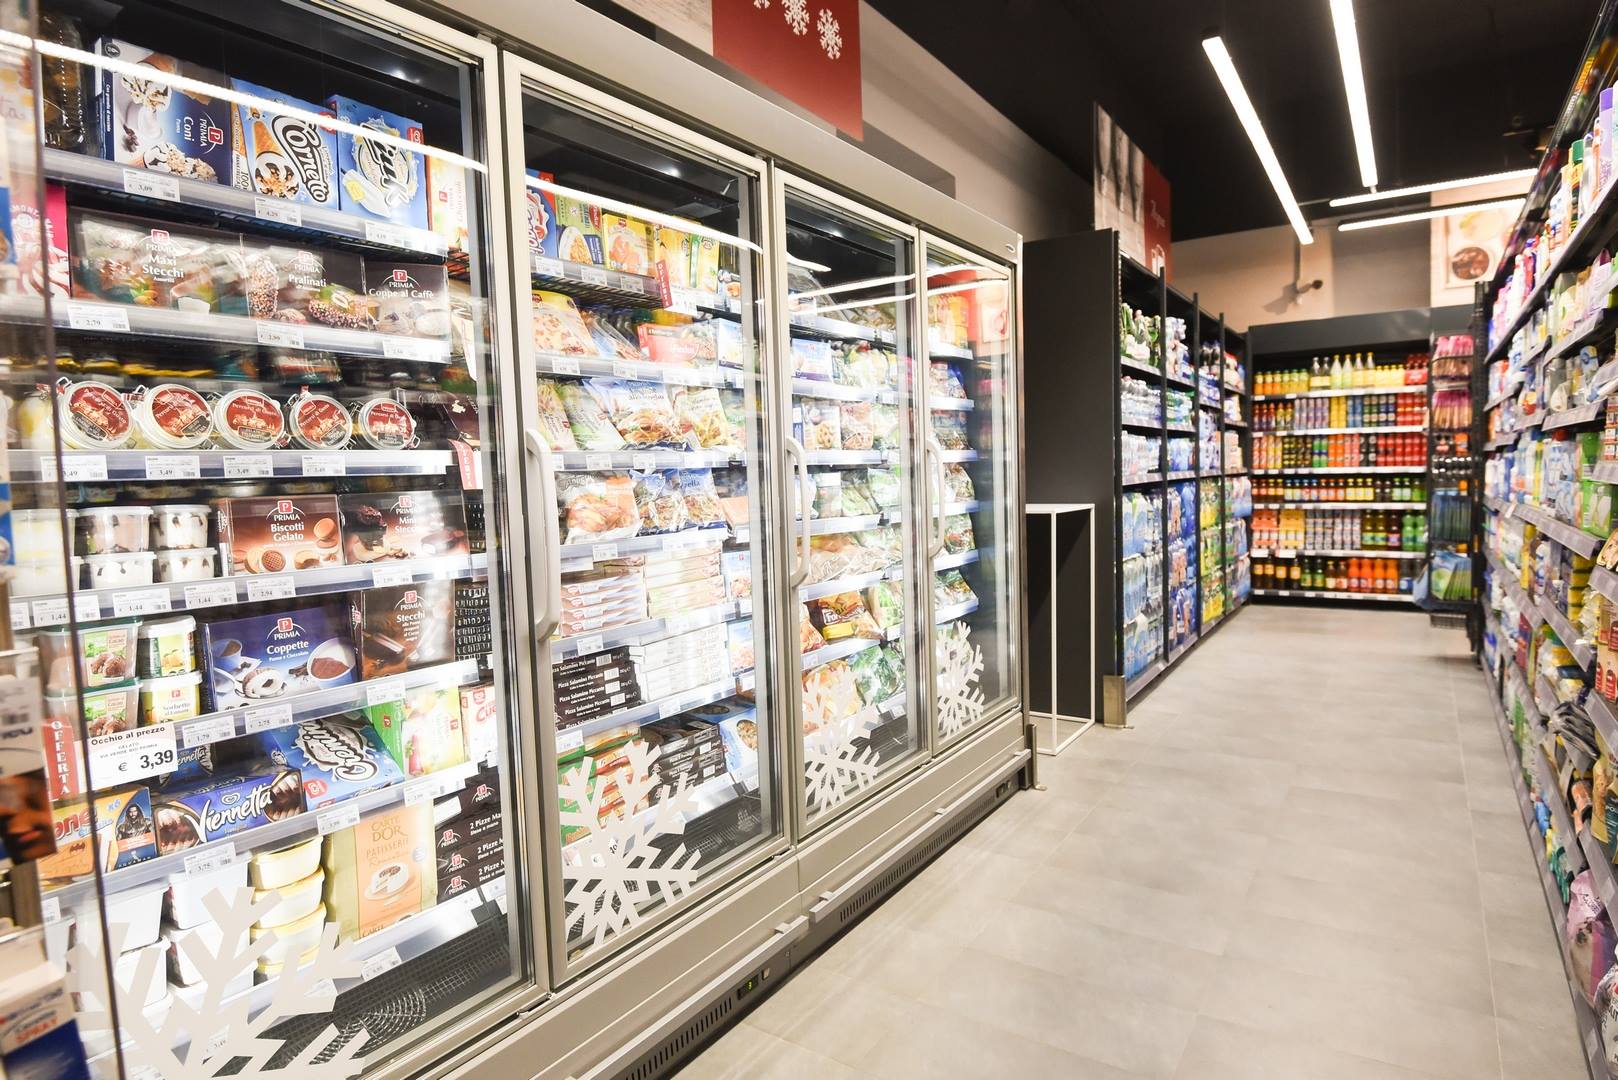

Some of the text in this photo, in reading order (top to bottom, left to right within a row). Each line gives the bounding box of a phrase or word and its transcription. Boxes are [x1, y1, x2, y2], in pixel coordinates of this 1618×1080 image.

[184, 116, 195, 142] Coni
[199, 118, 208, 147] PRIMIA
[272, 115, 329, 203] Cornetto
[150, 254, 177, 266] Maxi
[142, 263, 184, 278] Stecchi
[288, 273, 327, 288] Pralinati
[389, 281, 414, 289] PRIMIA
[369, 288, 399, 298] Coppe
[400, 289, 409, 298] al
[271, 522, 304, 533] Biscotti
[273, 533, 304, 542] Gelato
[401, 603, 423, 611] PRIMIA
[396, 610, 425, 623] Stecchi
[281, 621, 289, 630] P
[274, 630, 300, 641] PRIMIA
[267, 639, 309, 656] Coppette
[91, 726, 165, 746] Occhio al prezzo
[51, 720, 72, 796] OFFERTA
[118, 749, 174, 772] € 3,39
[475, 791, 492, 802] PRIMIA
[184, 783, 273, 843] Viennetta
[475, 816, 491, 829] Pizze
[441, 837, 458, 848] PRIMIA
[482, 840, 498, 852] Pizze
[449, 863, 466, 873] PRIMIA
[483, 862, 500, 874] Pizze
[449, 884, 466, 895] PRIMIA
